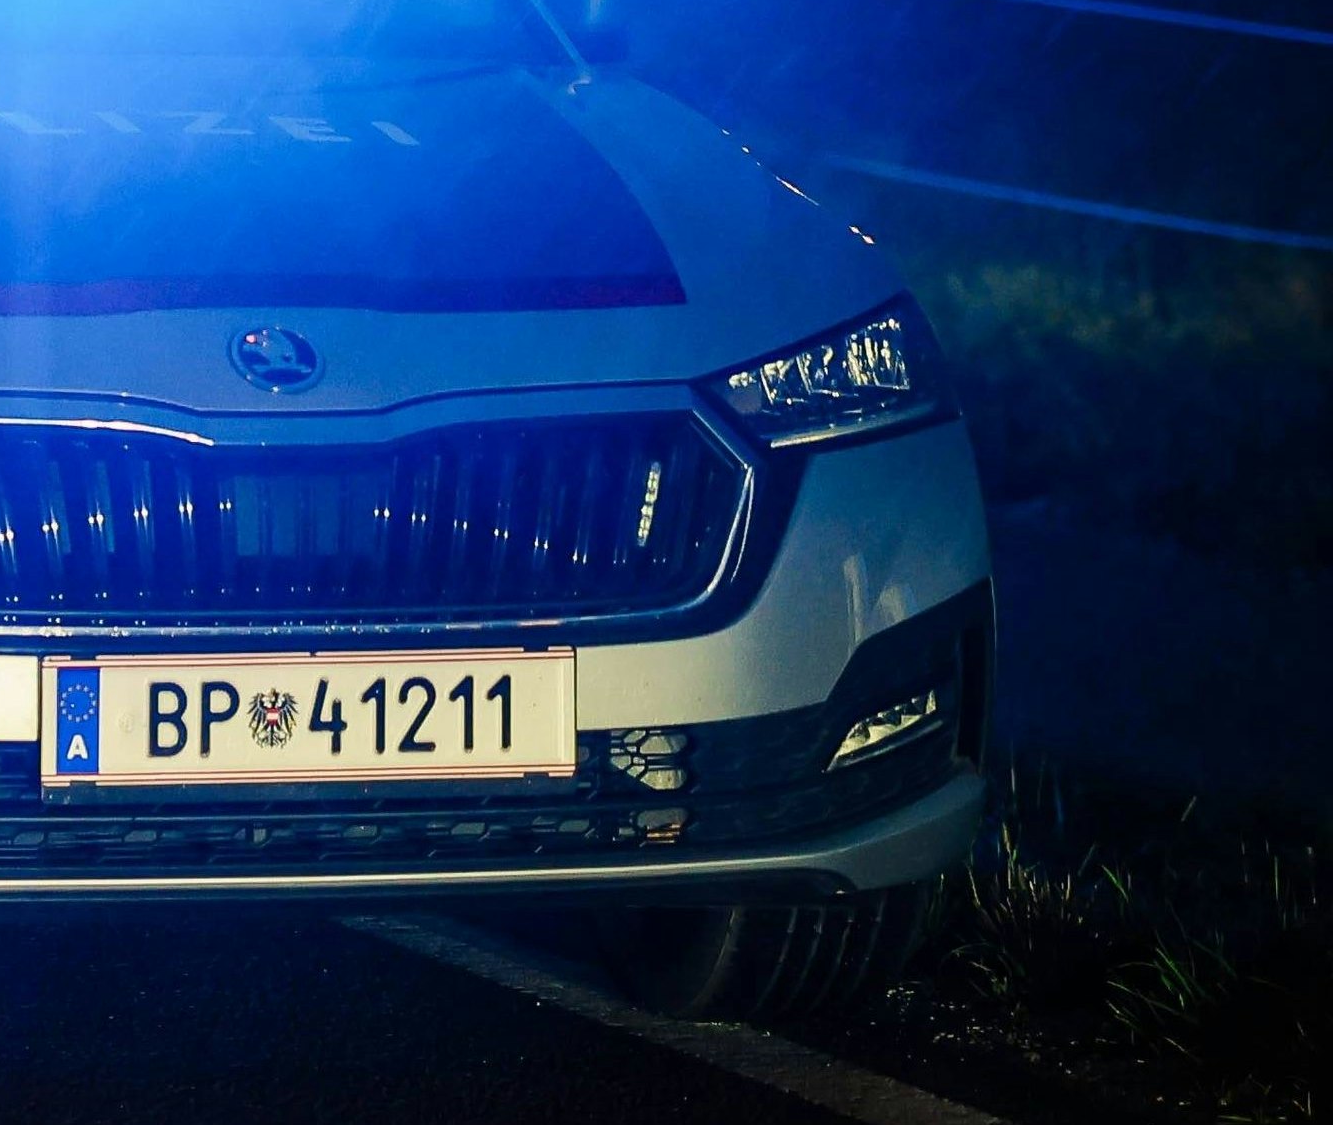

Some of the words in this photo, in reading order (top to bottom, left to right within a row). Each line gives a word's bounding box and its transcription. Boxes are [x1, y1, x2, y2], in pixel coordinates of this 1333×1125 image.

[146, 680, 240, 759] BP
[307, 674, 513, 756] 41211
[66, 733, 89, 761] A
